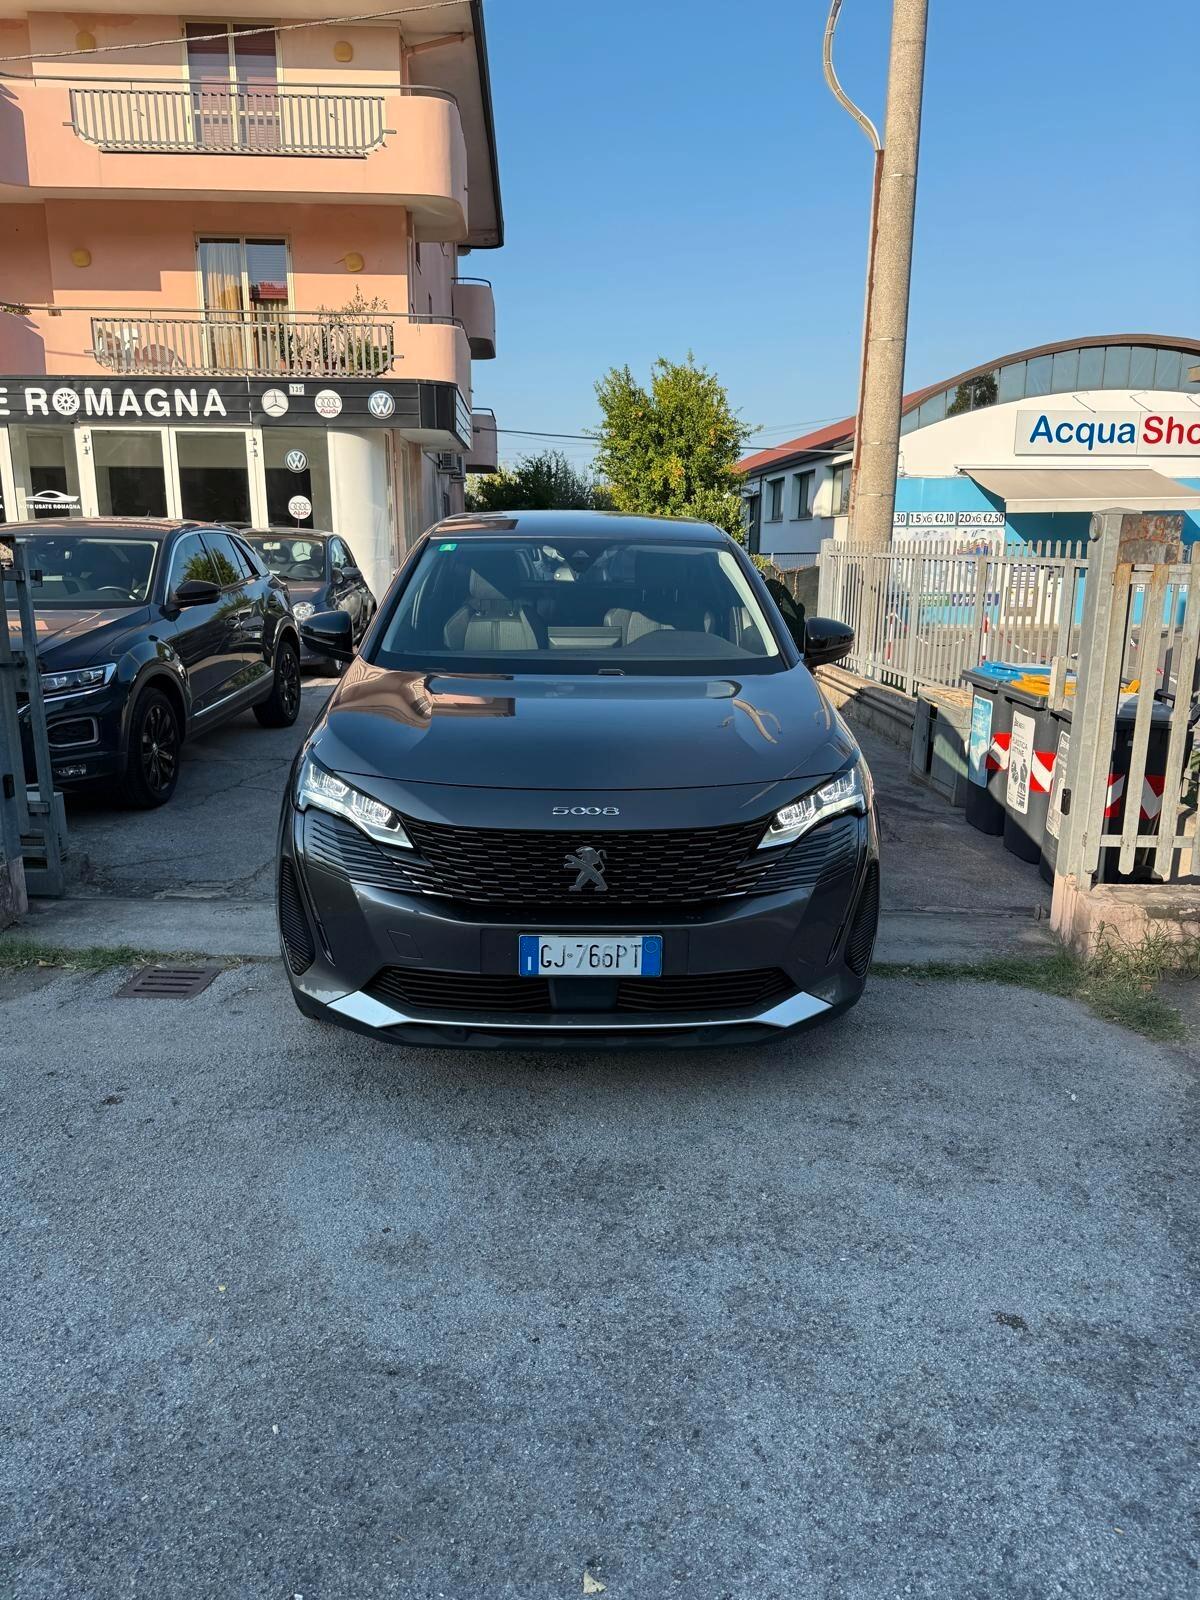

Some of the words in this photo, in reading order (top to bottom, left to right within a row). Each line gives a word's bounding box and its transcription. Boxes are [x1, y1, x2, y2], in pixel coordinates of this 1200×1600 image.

[24, 387, 228, 417] ROMAGNA
[1029, 414, 1136, 451] Acqua
[934, 513, 954, 524] €2,10
[983, 513, 1004, 524] €2,50
[552, 806, 620, 816] 5008
